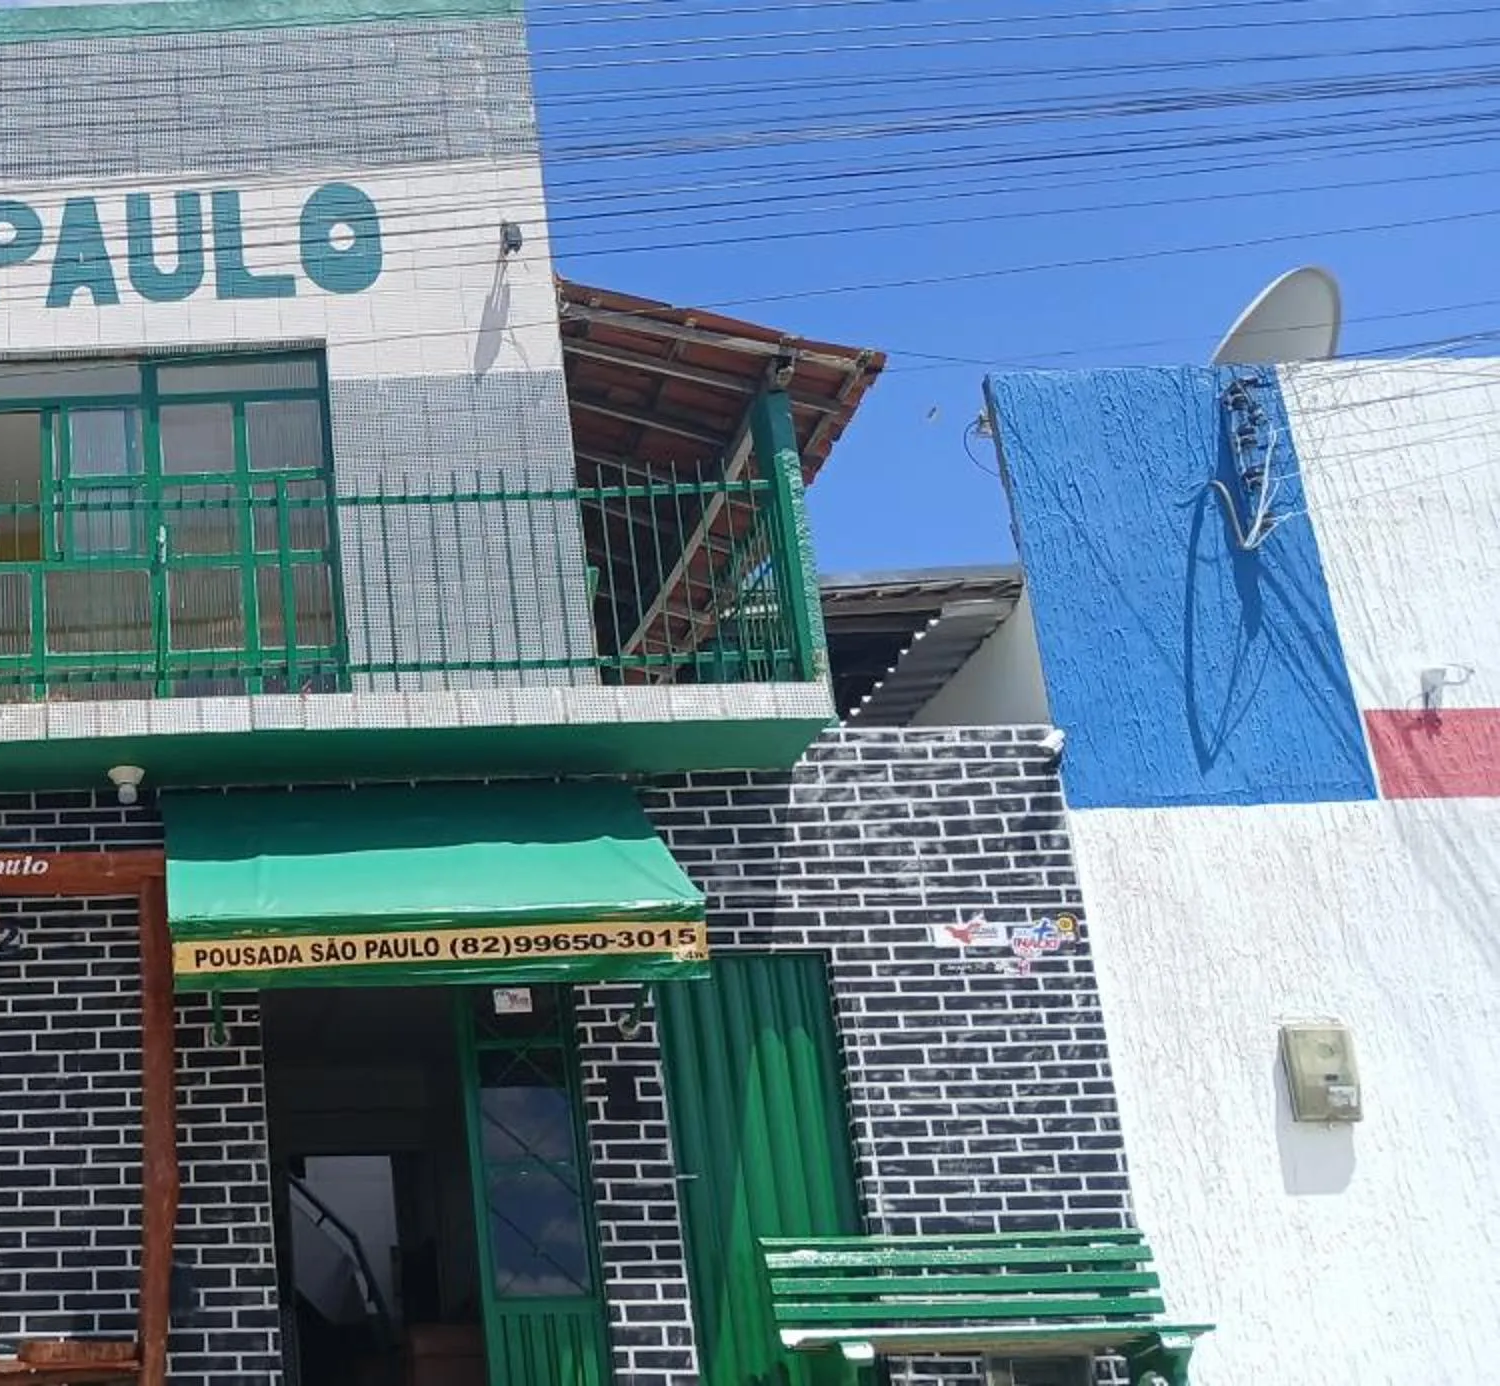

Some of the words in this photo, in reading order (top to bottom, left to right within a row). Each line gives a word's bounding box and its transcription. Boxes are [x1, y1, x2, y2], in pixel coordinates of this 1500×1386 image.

[195, 944, 303, 968] POUSADA
[311, 938, 357, 962] SÃO
[365, 937, 440, 959] PAULO
[449, 927, 697, 958] (82)99650-3015
